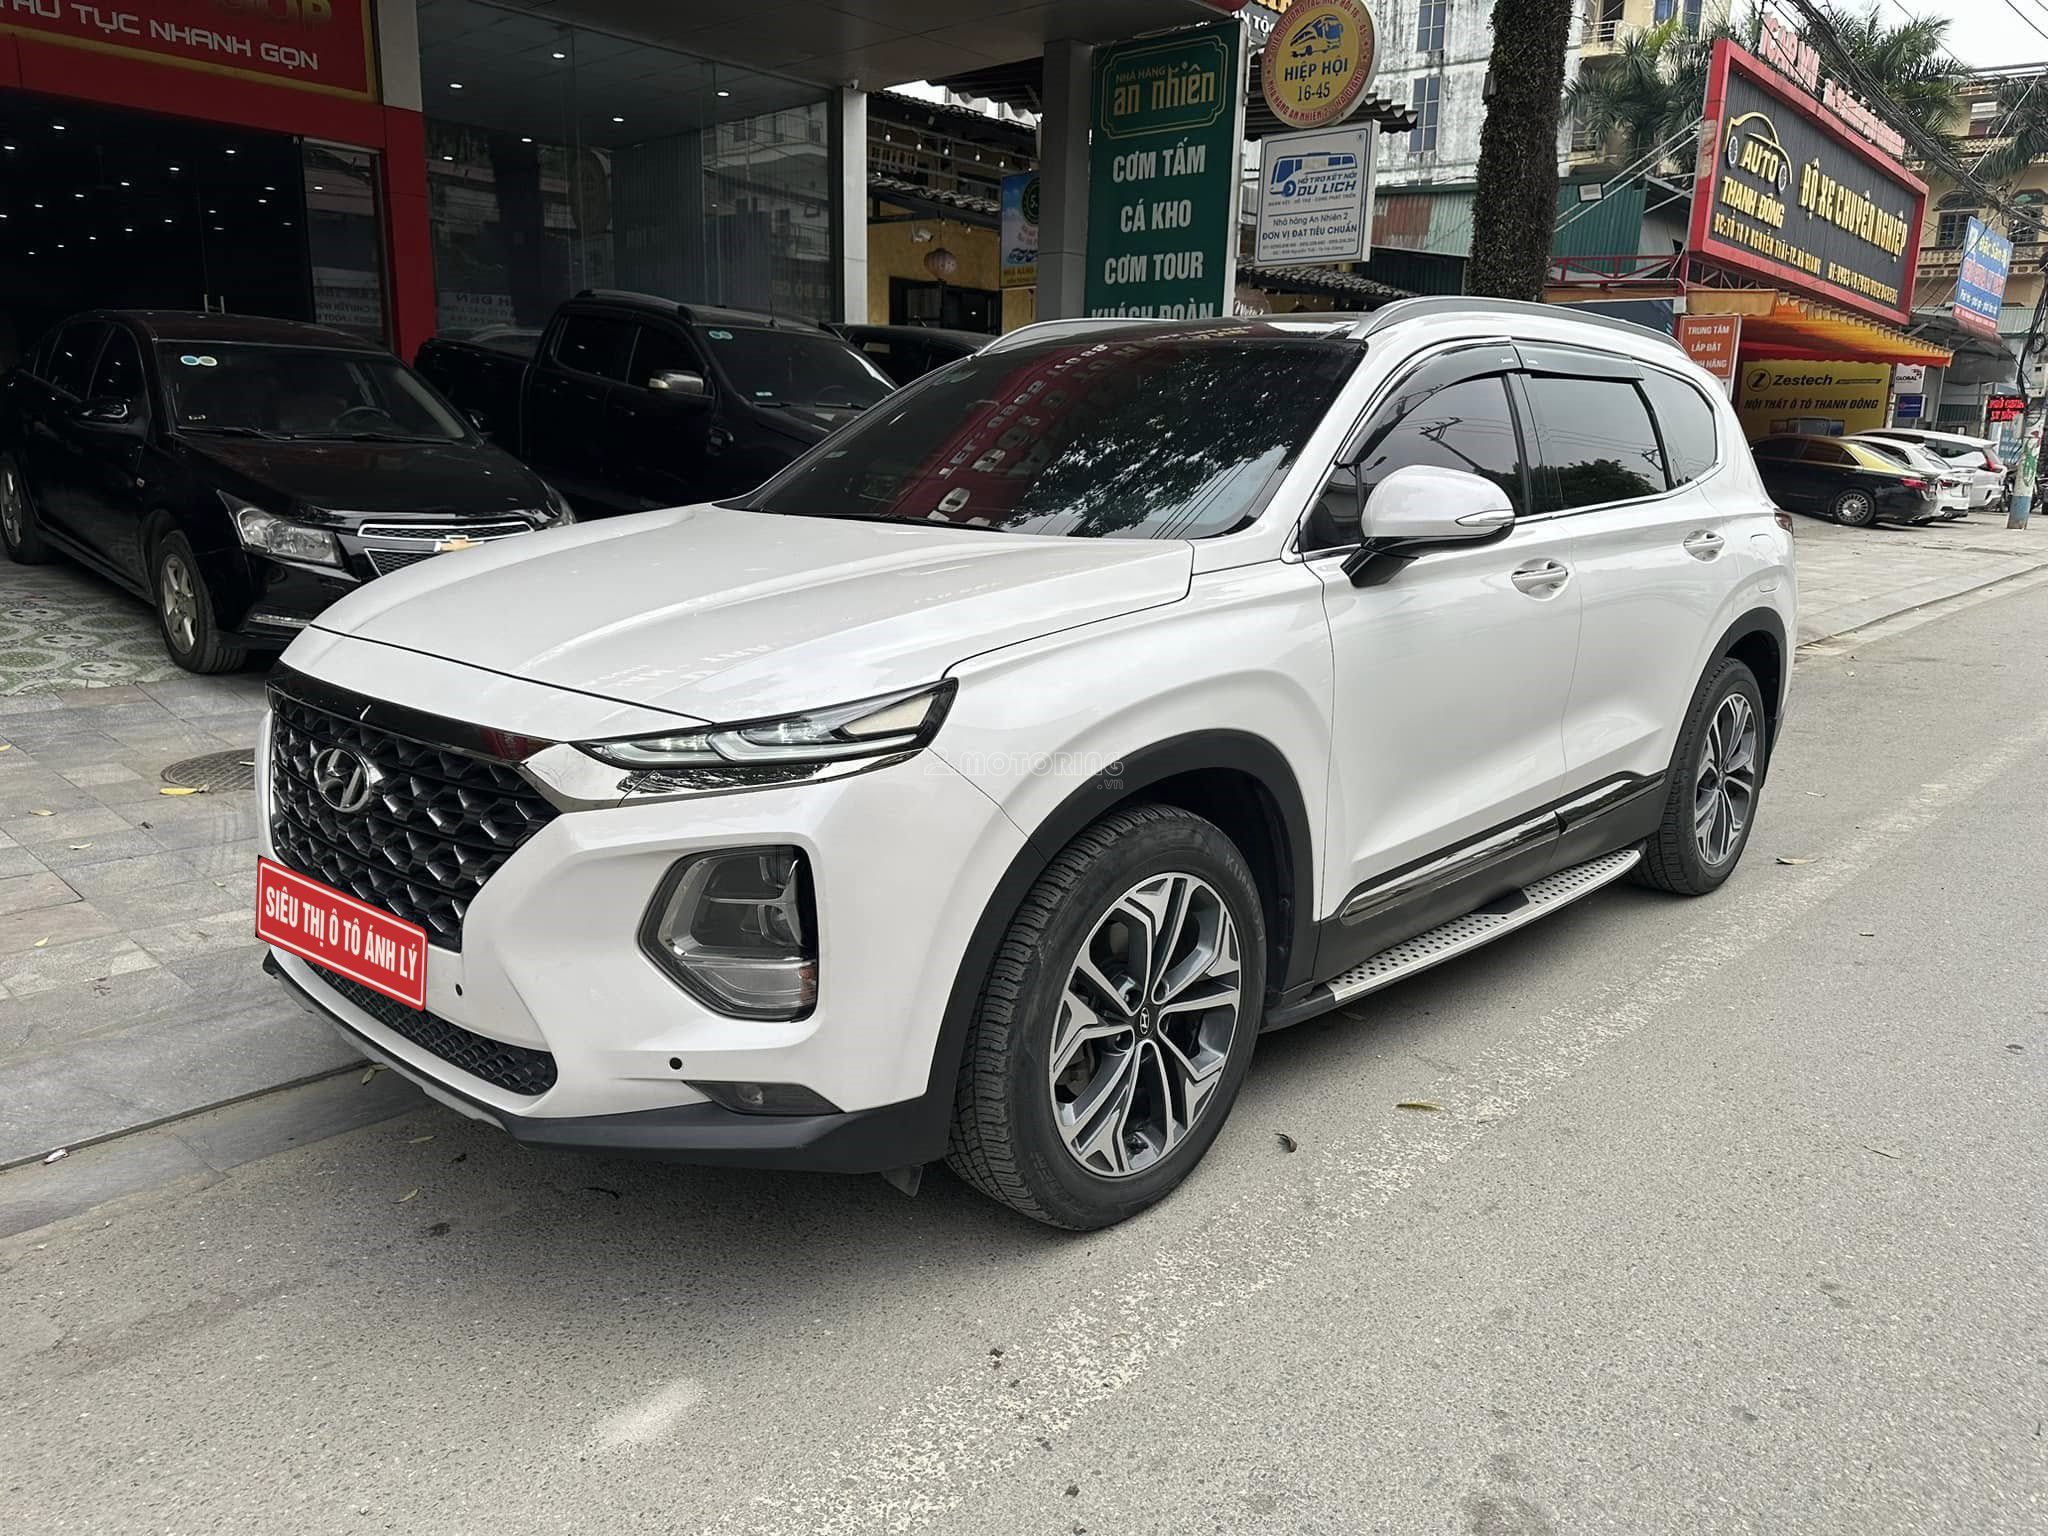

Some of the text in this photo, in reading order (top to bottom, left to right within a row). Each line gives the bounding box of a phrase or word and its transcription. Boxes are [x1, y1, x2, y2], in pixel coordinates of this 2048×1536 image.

[70, 2, 140, 34] TỤC
[150, 19, 251, 57] NHANH
[260, 42, 319, 71] GỌN
[1284, 55, 1348, 82] HIỆP HỘI
[1113, 84, 1140, 116] an
[1298, 82, 1330, 102] 16-45
[1112, 137, 1206, 183] CƠM TẤM
[1739, 141, 1779, 183] AUTO
[1297, 184, 1318, 196] DU
[1721, 176, 1757, 215] THANH
[1120, 198, 1192, 233] CÁ KHO
[1309, 214, 1320, 223] An
[1343, 212, 1348, 220] 2
[1818, 174, 1836, 221] XE
[1835, 190, 1875, 241] CHUYÊN
[1873, 210, 1908, 263] NGHIỆP
[1104, 251, 1204, 285] CƠM TOUR
[1688, 326, 1712, 335] TRUNG
[1772, 374, 1833, 386] Zestech
[1815, 399, 1848, 409] THANH
[265, 886, 418, 981] SIÊU THỊ Ô TÔ ÁNH LÝ
